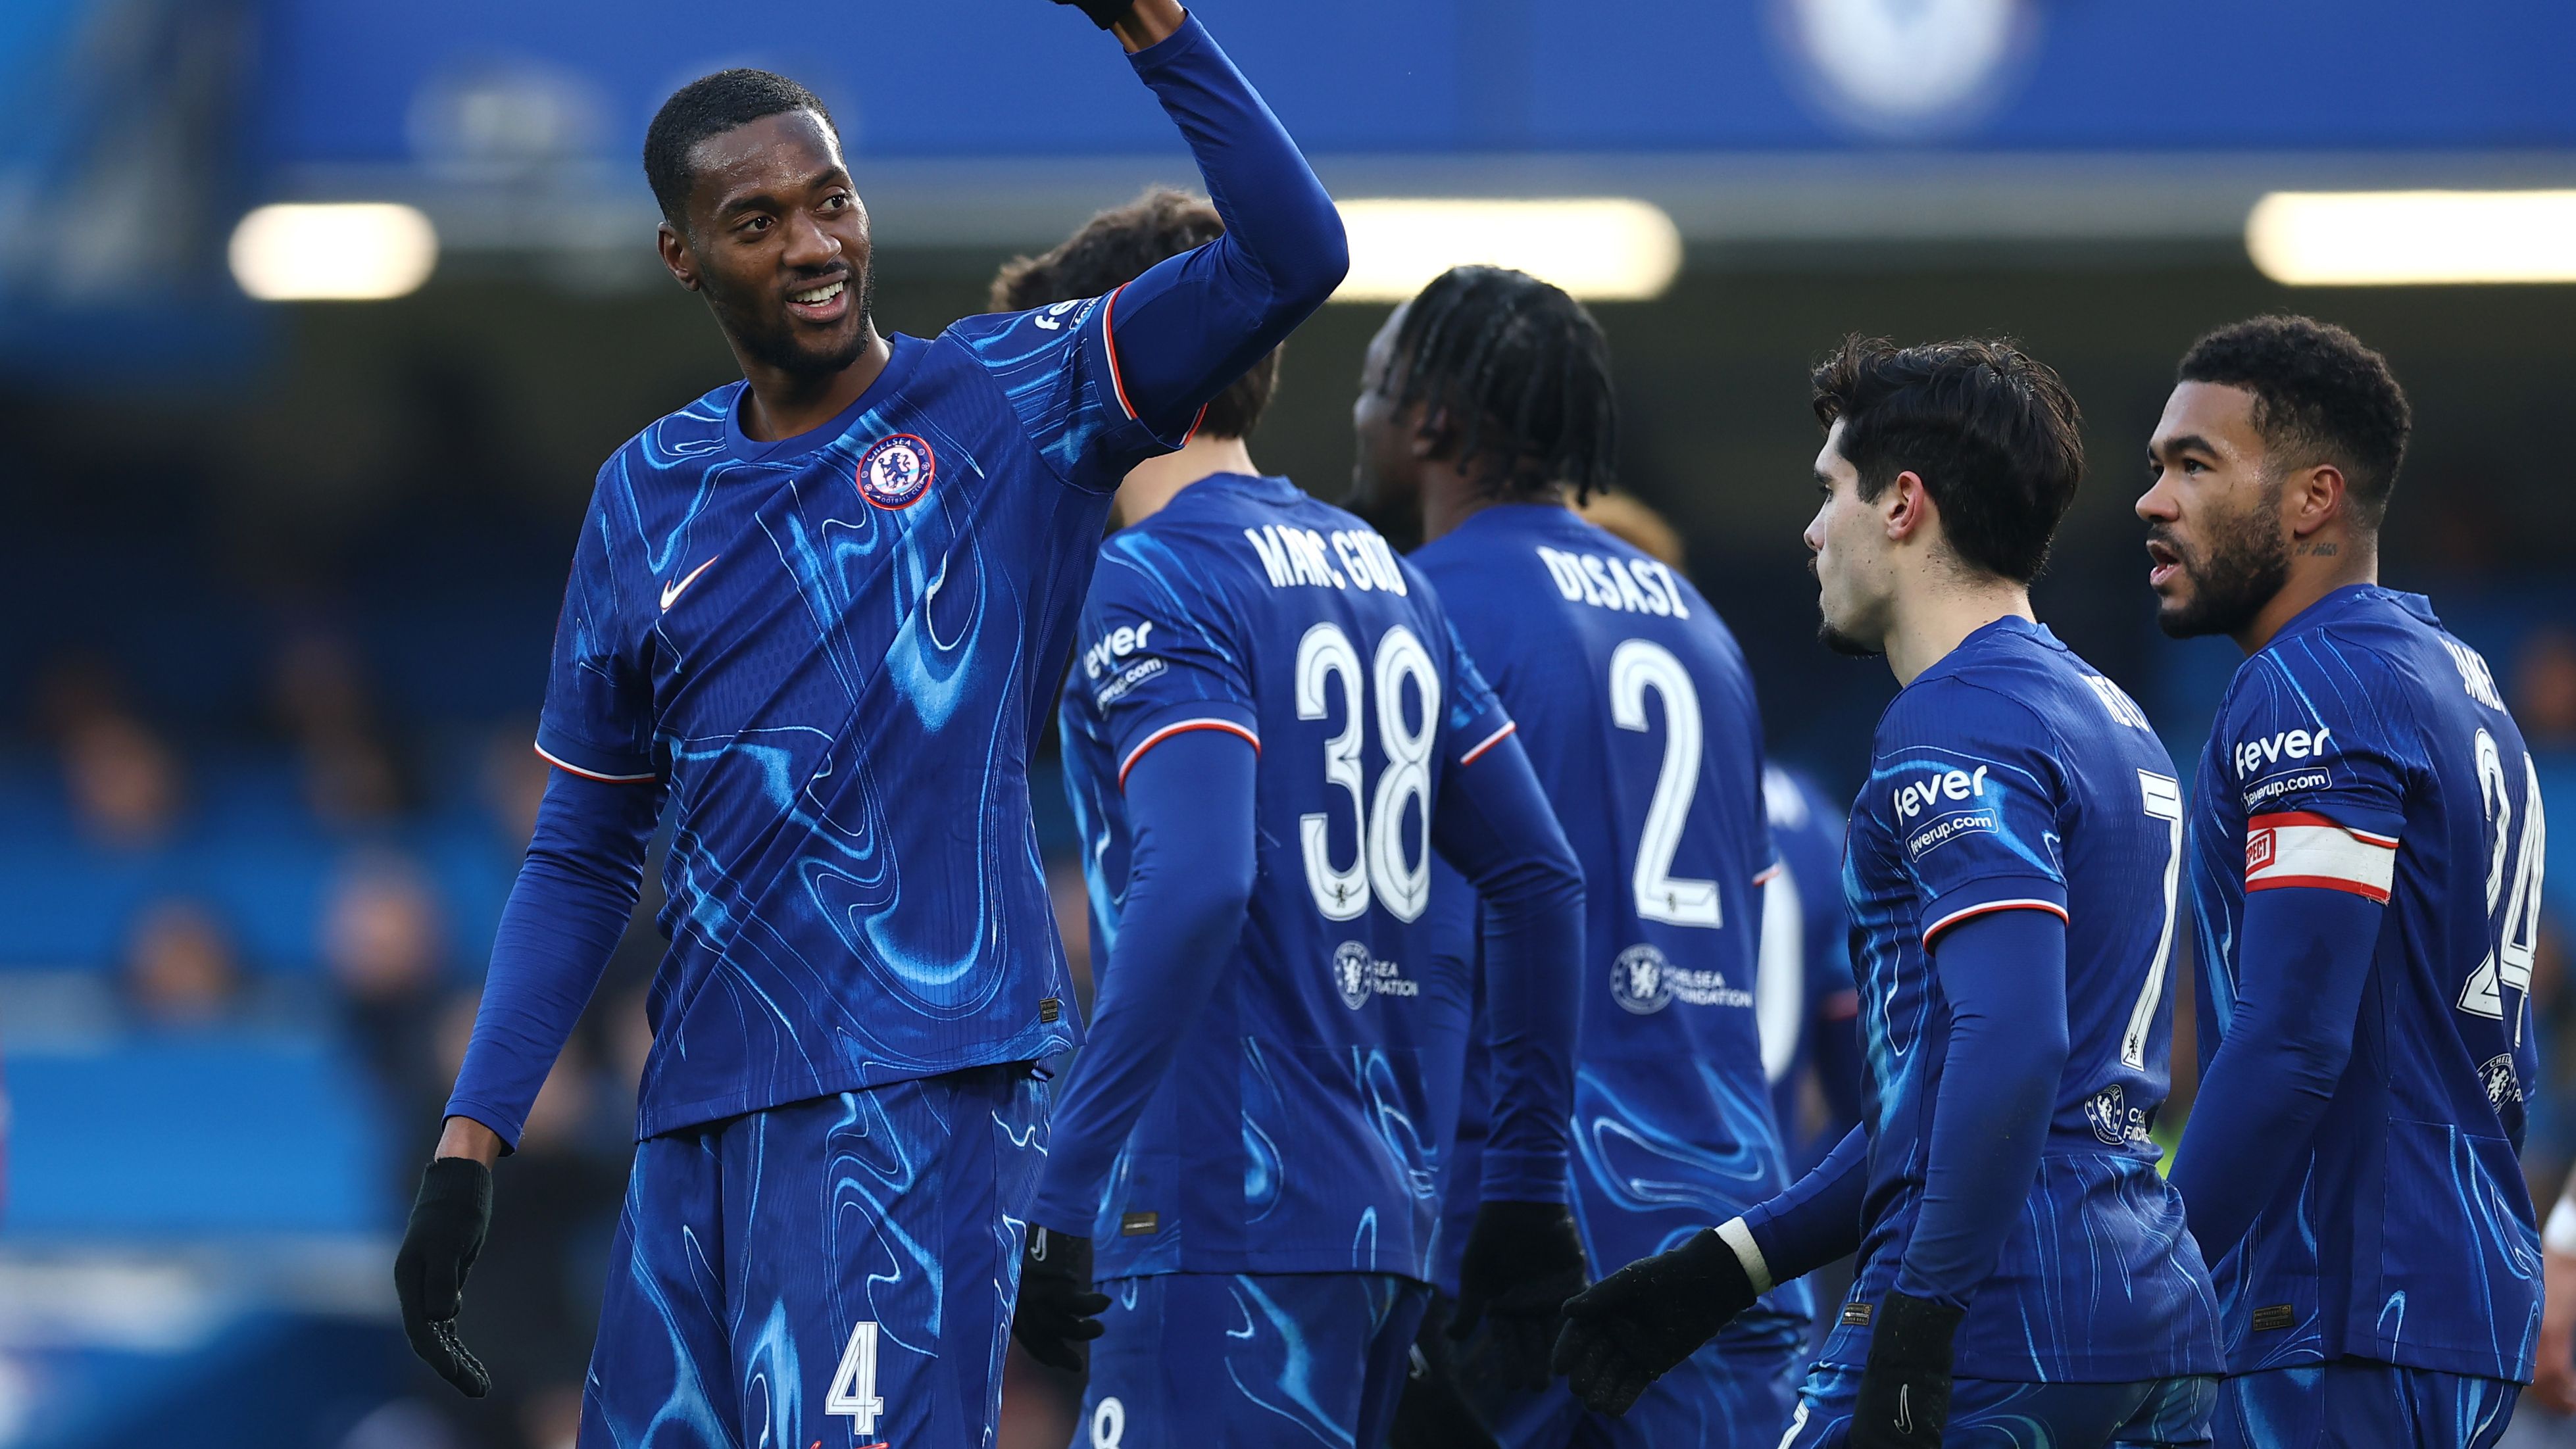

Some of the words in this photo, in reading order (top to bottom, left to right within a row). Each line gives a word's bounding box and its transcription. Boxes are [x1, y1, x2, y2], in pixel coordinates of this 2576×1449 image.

[866, 437, 912, 462] CHELSEA
[877, 495, 910, 504] FOOTBALL
[911, 479, 926, 495] CLUB
[1535, 546, 1691, 621] DISASI
[1083, 620, 1153, 680] ever
[1296, 620, 1442, 923] 38
[1608, 637, 1723, 929] 2
[2235, 727, 2330, 781] fever
[1894, 764, 1988, 827] fever
[2244, 774, 2326, 807] feverup.com
[1910, 816, 1993, 856] feverup.com
[2246, 837, 2267, 866] PECT
[2456, 727, 2546, 1048] 24
[2119, 767, 2183, 1071] 7
[2490, 1056, 2514, 1071] CHEL
[825, 1321, 883, 1436] 4
